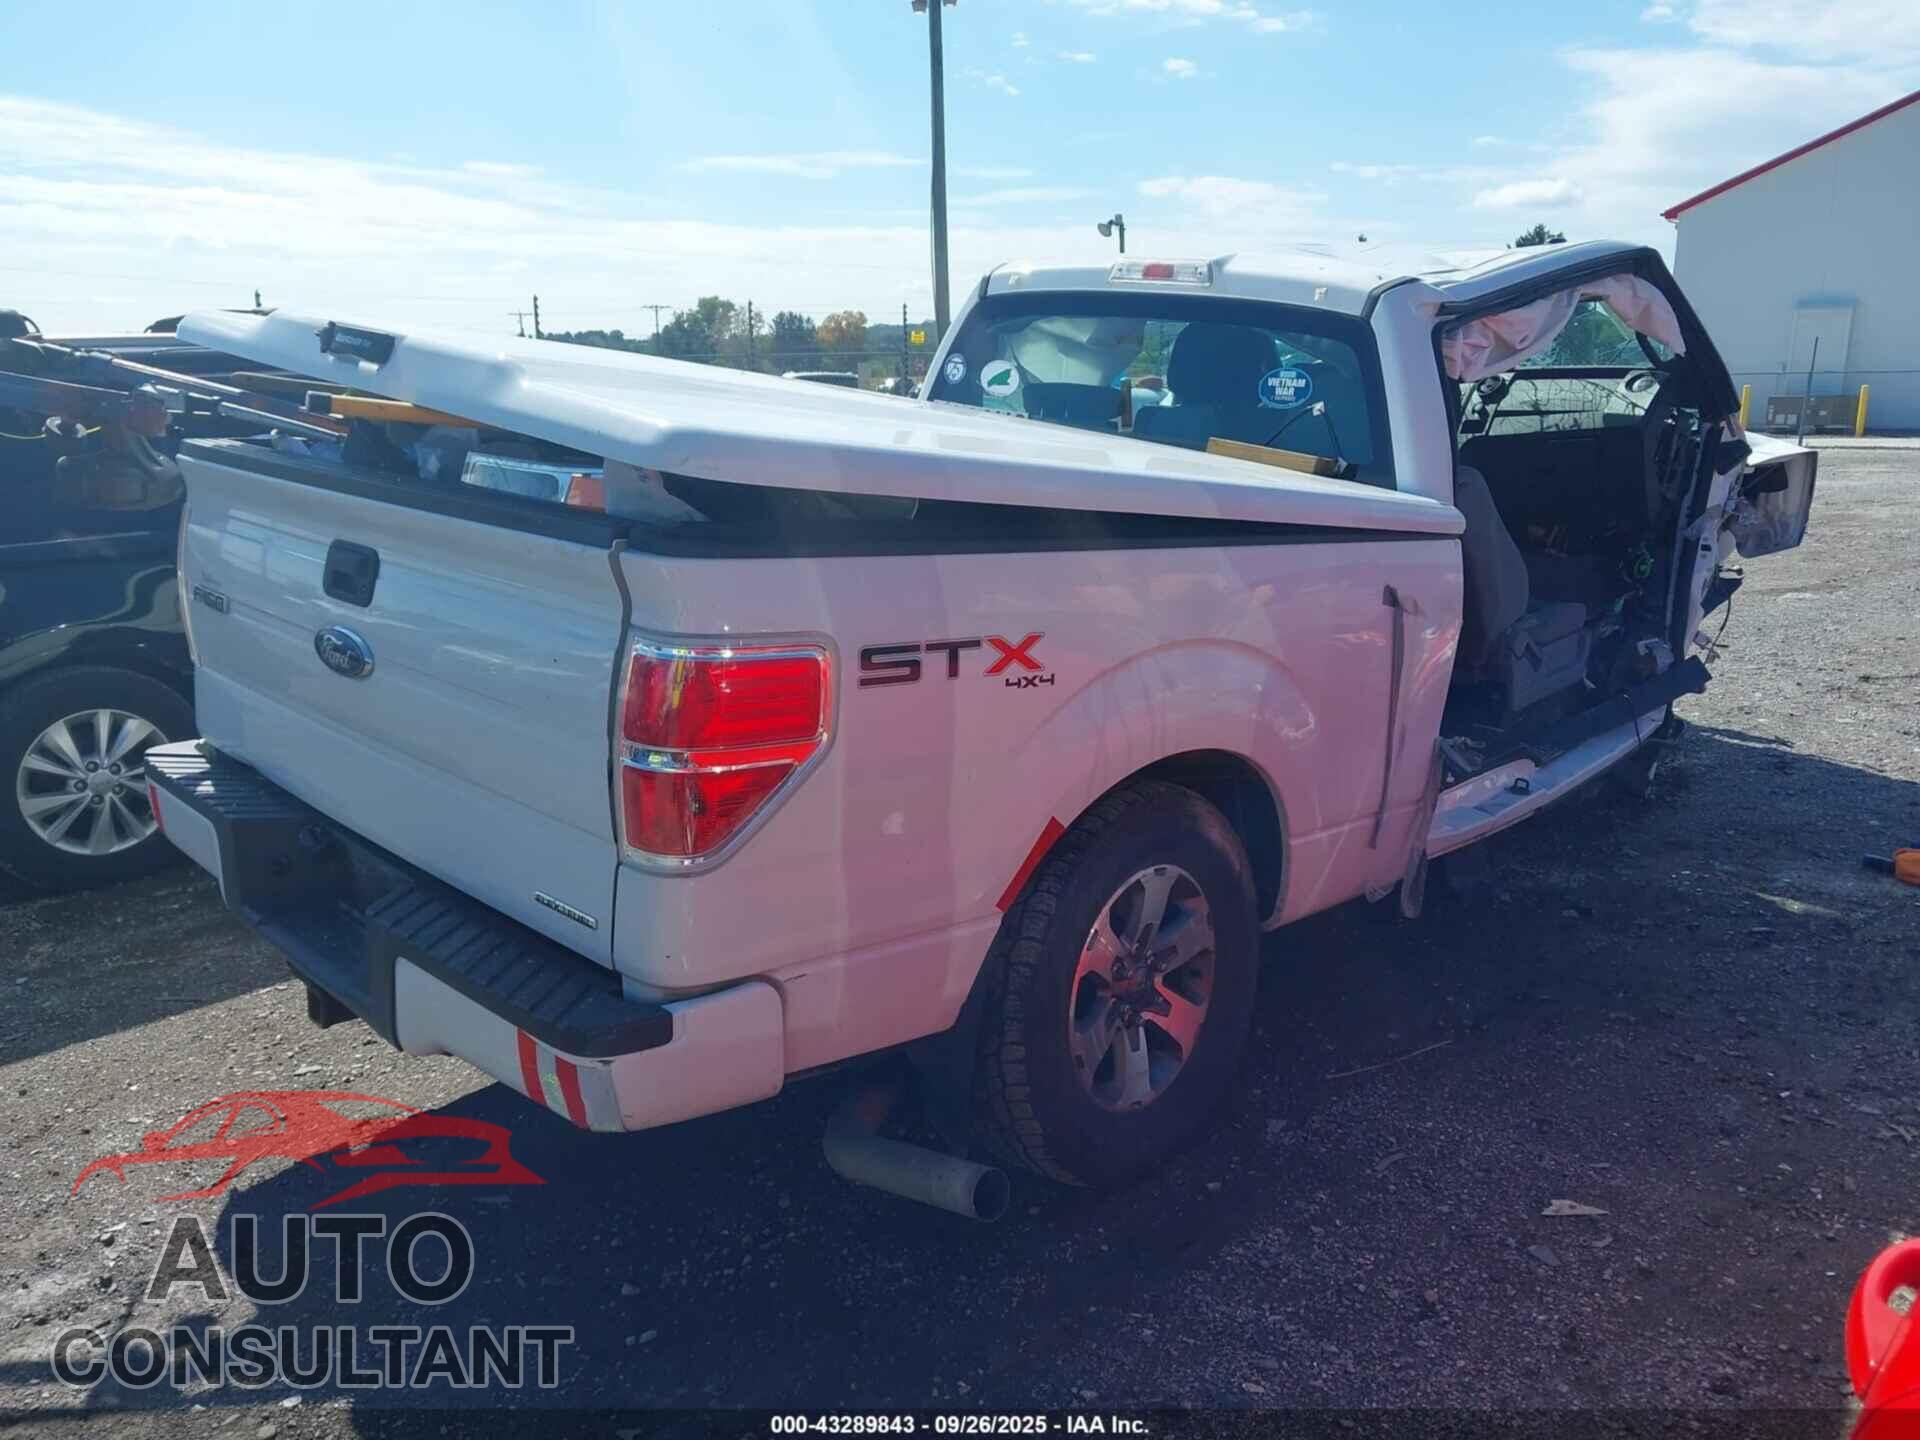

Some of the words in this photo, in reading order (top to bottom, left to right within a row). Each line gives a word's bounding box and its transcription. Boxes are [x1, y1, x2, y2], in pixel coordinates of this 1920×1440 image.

[1267, 377, 1306, 388] VIETNAM
[1275, 386, 1295, 396] WAR
[857, 631, 1045, 689] STX
